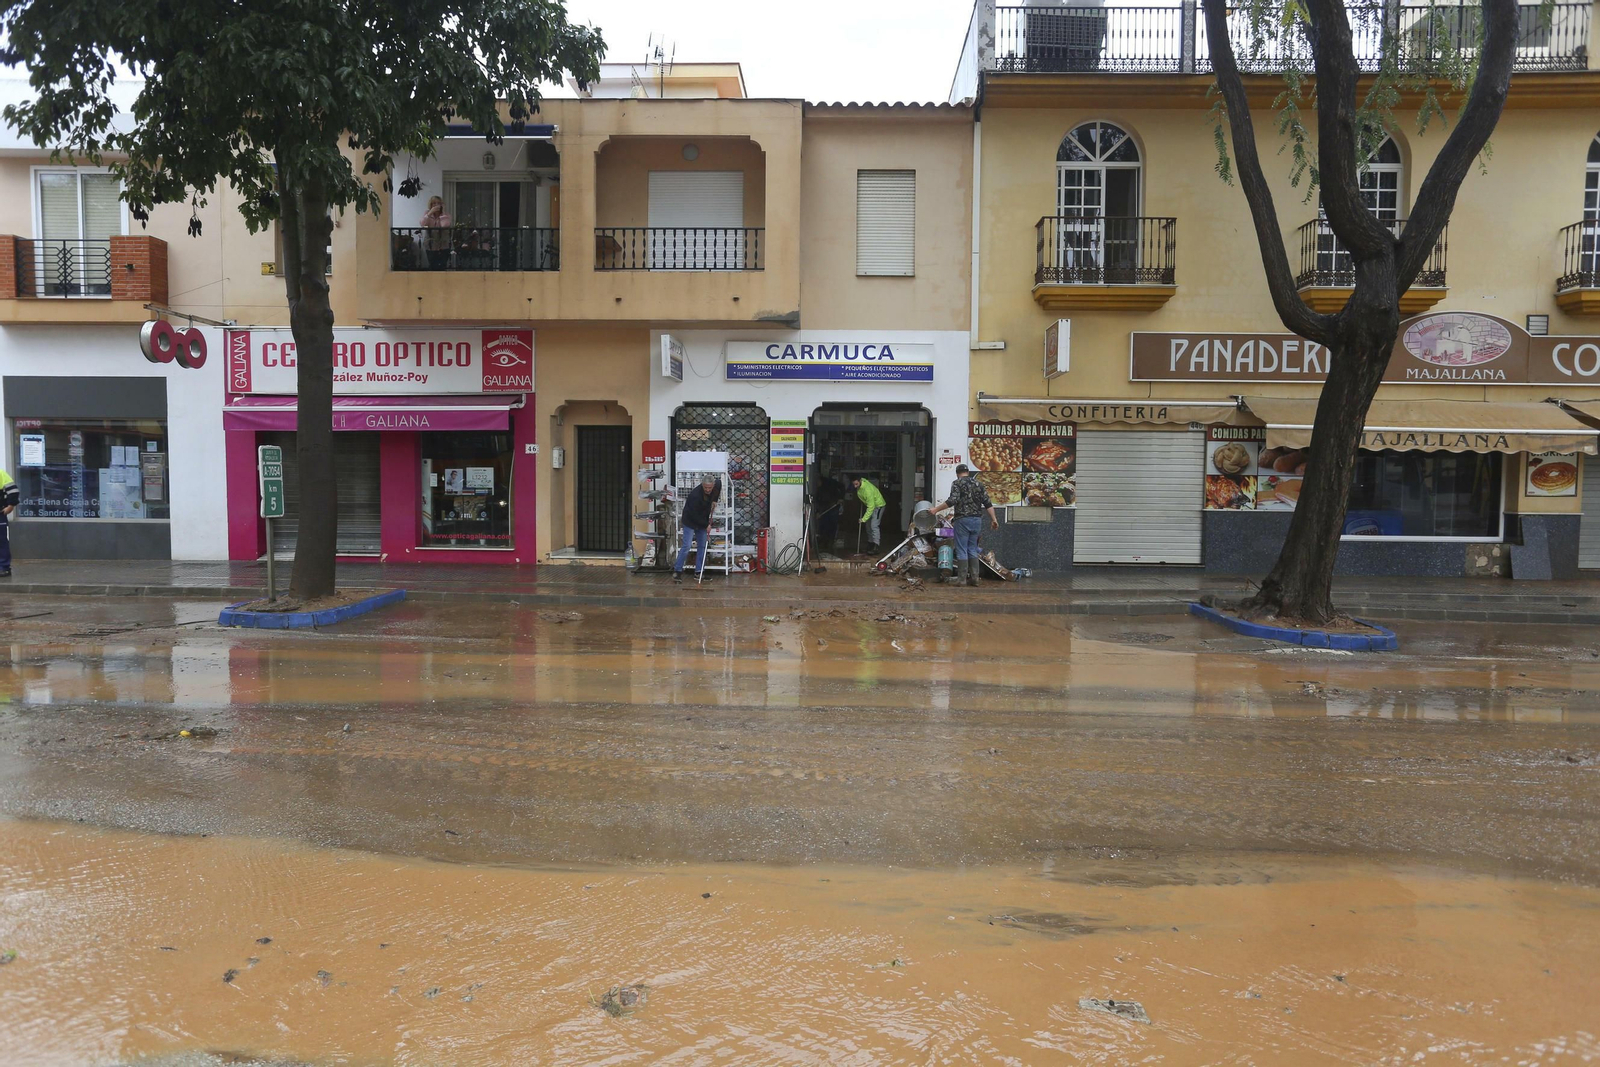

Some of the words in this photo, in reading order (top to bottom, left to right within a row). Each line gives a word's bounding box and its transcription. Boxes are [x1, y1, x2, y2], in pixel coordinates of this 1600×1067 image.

[262, 342, 366, 368] CERO
[375, 342, 472, 367] OPTICO
[765, 344, 895, 360] CARMUCA
[1170, 339, 1332, 373] PANADERI
[234, 334, 248, 389] GALIANA
[366, 371, 428, 384] Muñoz-Poy
[1406, 368, 1506, 380] MAJALLANA
[483, 375, 532, 387] GALIANA
[1048, 405, 1168, 419] CONFITERIA
[366, 414, 430, 428] GALIANA
[973, 424, 1013, 436] COMIDAS
[1014, 424, 1038, 436] PARA
[1040, 425, 1074, 437] LLEVAR
[1212, 427, 1249, 439] COMIDAS
[527, 445, 537, 453] 46
[264, 466, 281, 476] A-7054
[268, 485, 278, 493] km
[38, 498, 60, 506] Elena
[270, 497, 277, 511] 5
[38, 509, 67, 517] Sandra
[430, 532, 512, 540] www.opticagaliana.com
